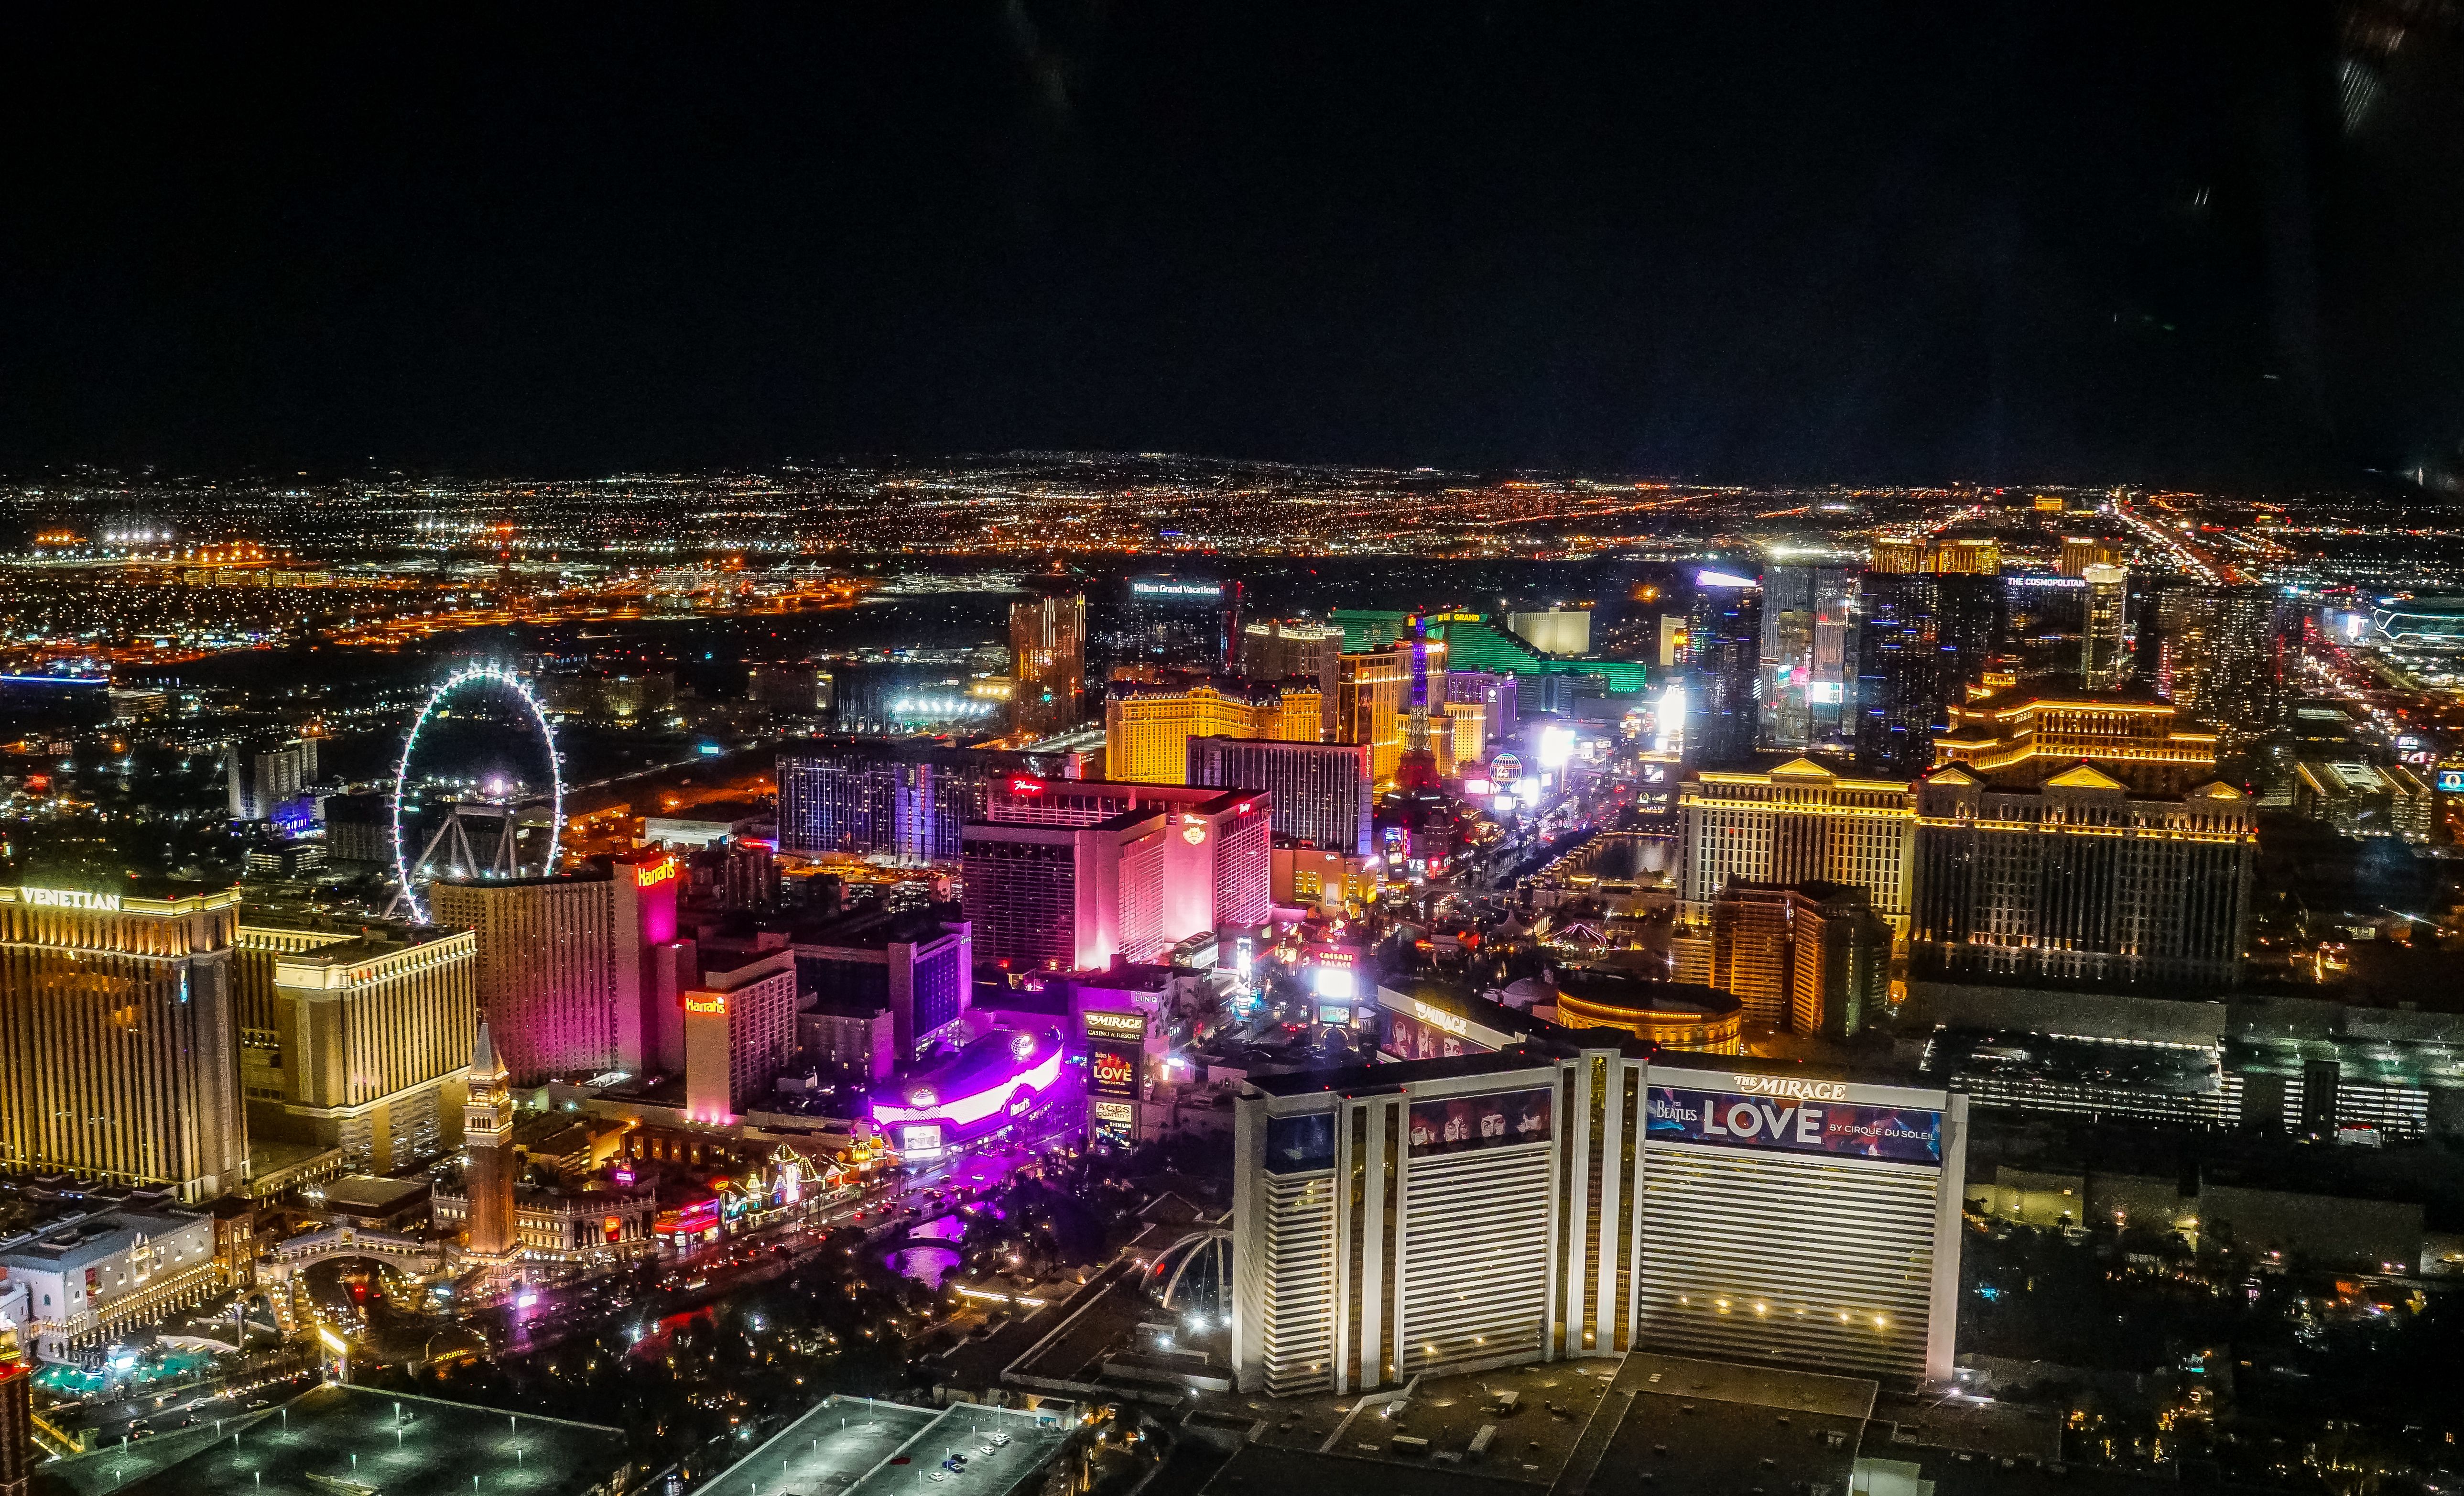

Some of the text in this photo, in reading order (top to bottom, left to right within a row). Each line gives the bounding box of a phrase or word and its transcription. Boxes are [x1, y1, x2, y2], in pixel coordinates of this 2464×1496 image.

[1134, 584, 1219, 594] Hilton Grand Vacations
[2008, 577, 2085, 587] THE COSMOPOLITAN
[20, 886, 120, 911] VENETIAN
[1319, 952, 1353, 961] CAESARS
[1321, 960, 1351, 969] PALACE
[1089, 1016, 1142, 1029] MIRAGE
[1418, 1006, 1466, 1035] MIRAGE
[1094, 1065, 1132, 1081] LOVE
[1734, 1076, 1846, 1100] THE MIRAGE
[1097, 1104, 1130, 1114] ACES
[1097, 1111, 1130, 1119] COMEDY
[1656, 1100, 1697, 1123] BEATLES
[1704, 1100, 1823, 1144] LOVE
[1830, 1124, 1936, 1141] BY CIRQUE DU SOLEIL
